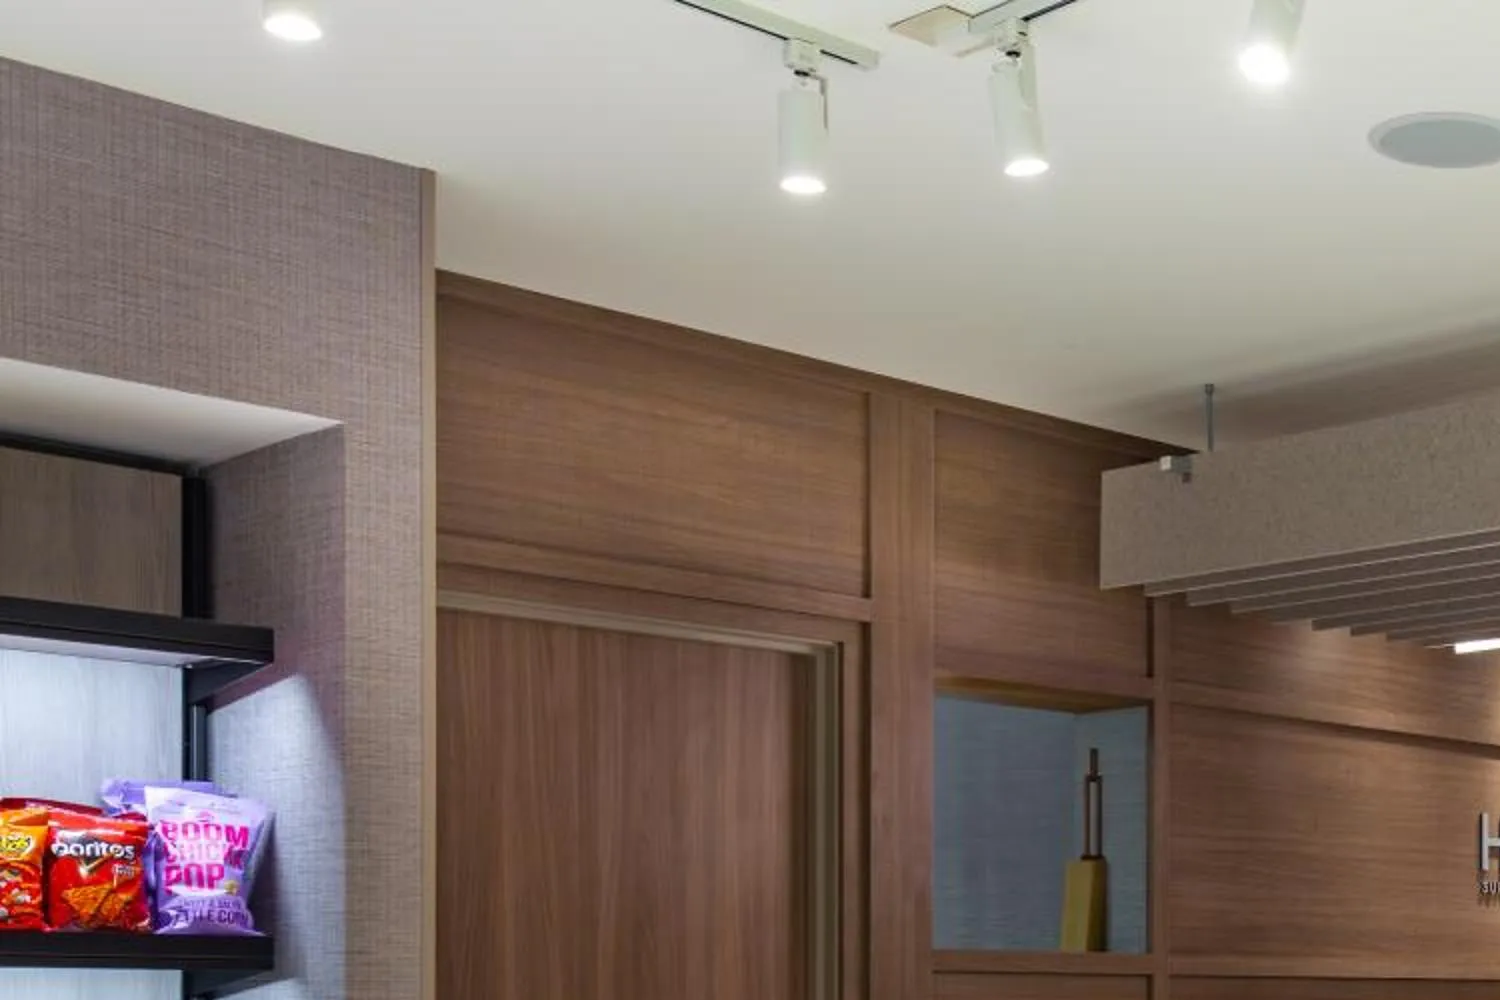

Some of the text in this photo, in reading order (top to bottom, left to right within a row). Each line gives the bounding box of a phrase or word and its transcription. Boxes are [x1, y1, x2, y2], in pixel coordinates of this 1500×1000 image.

[161, 820, 249, 848] BOOM
[51, 840, 135, 859] Doritos
[165, 864, 225, 893] POP
